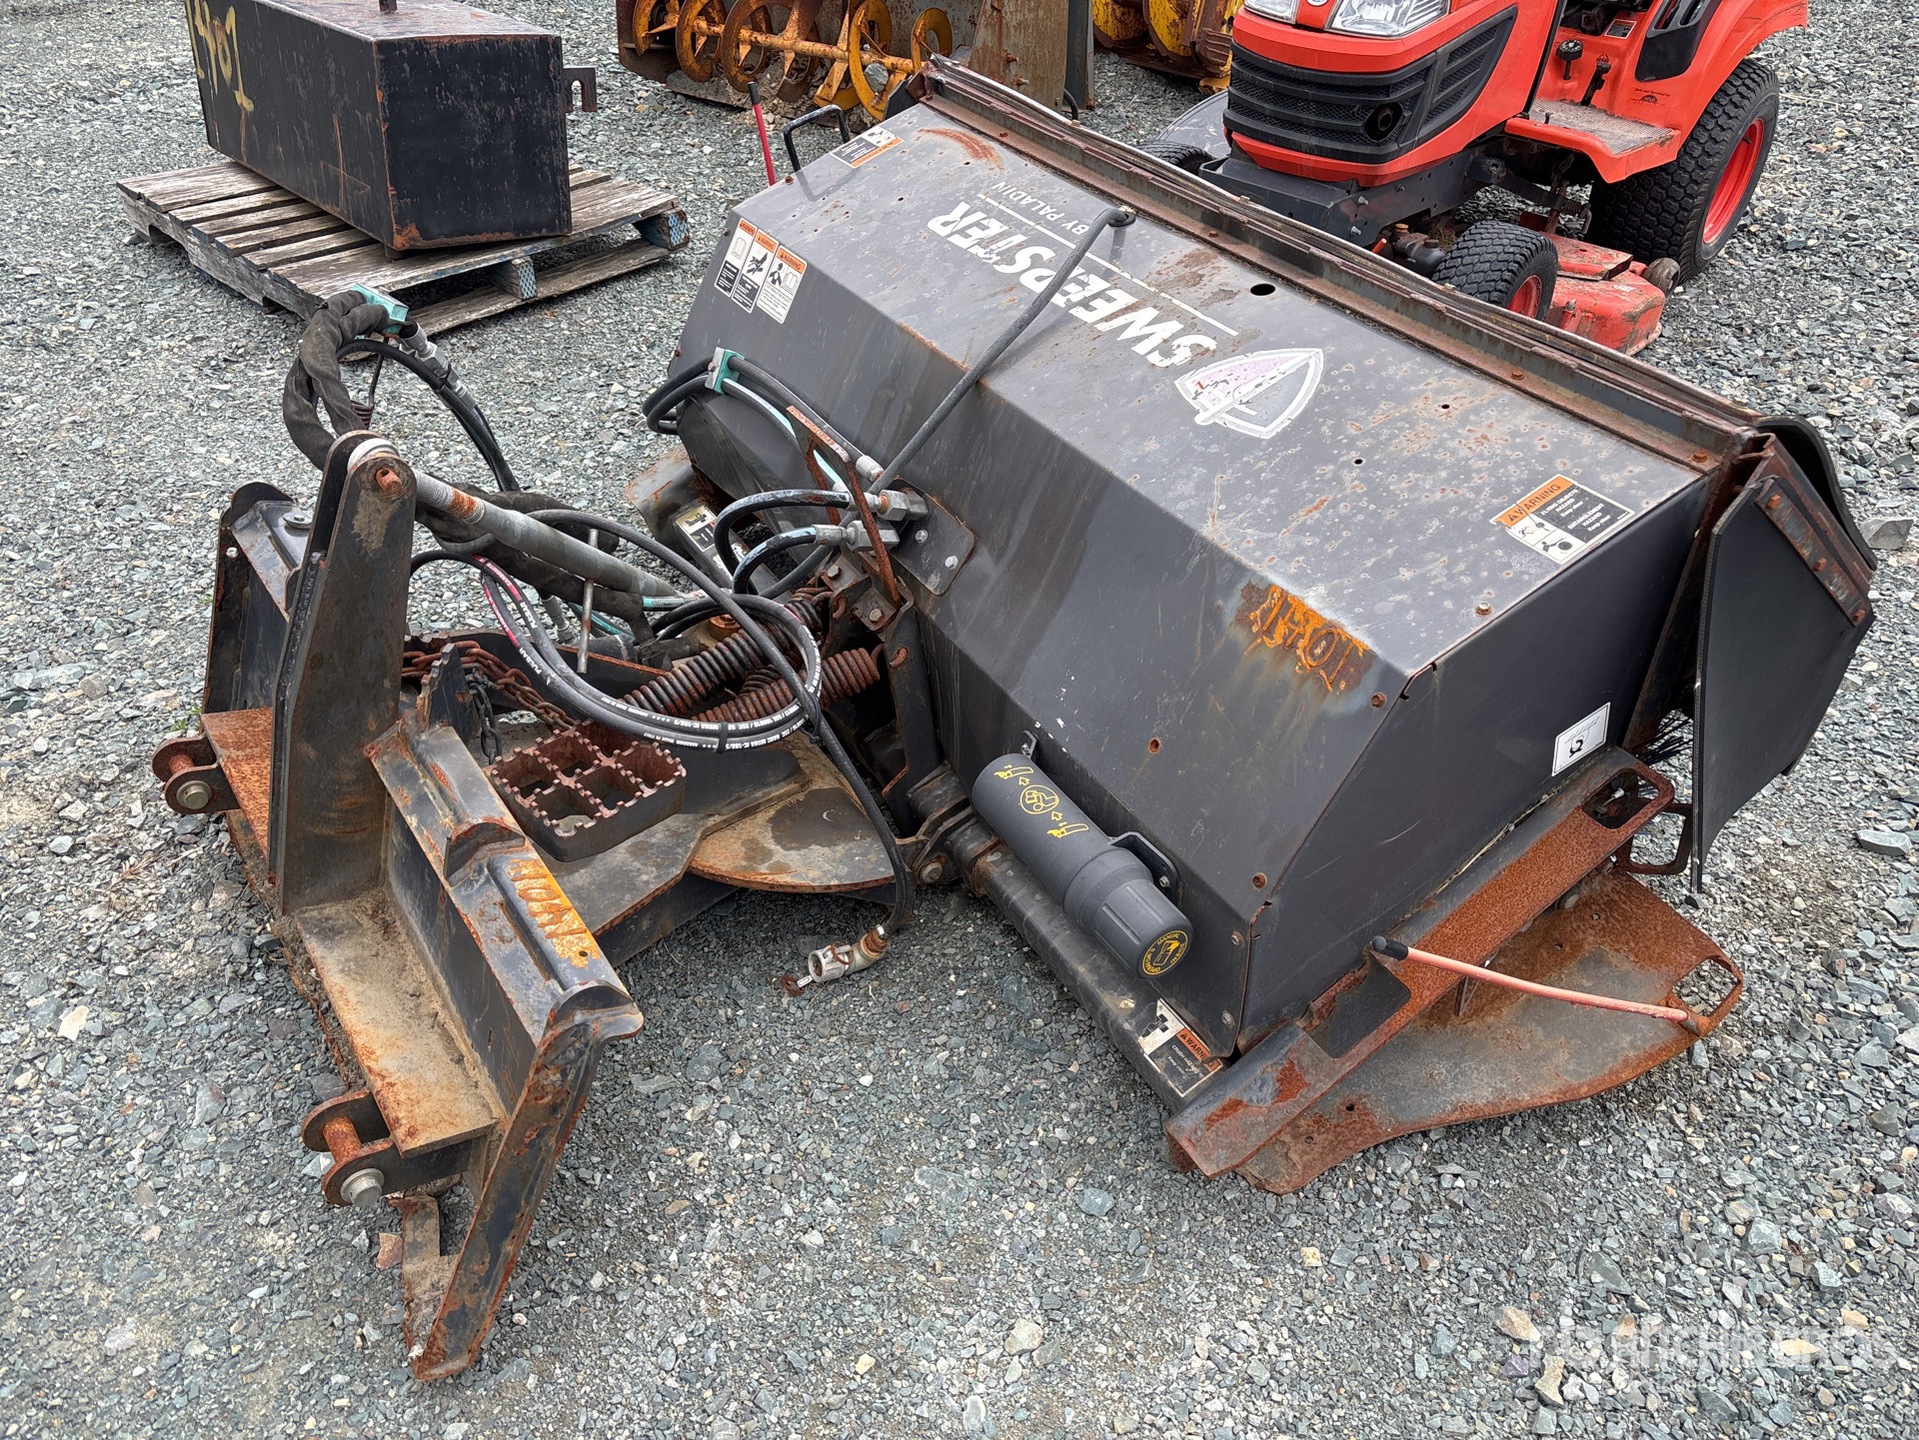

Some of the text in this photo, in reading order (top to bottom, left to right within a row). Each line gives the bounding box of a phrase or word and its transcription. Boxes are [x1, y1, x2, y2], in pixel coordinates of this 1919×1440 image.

[991, 181, 1090, 237] BY PALADIN
[927, 201, 1218, 368] SWEEPSTER
[1514, 483, 1562, 518] WARNING
